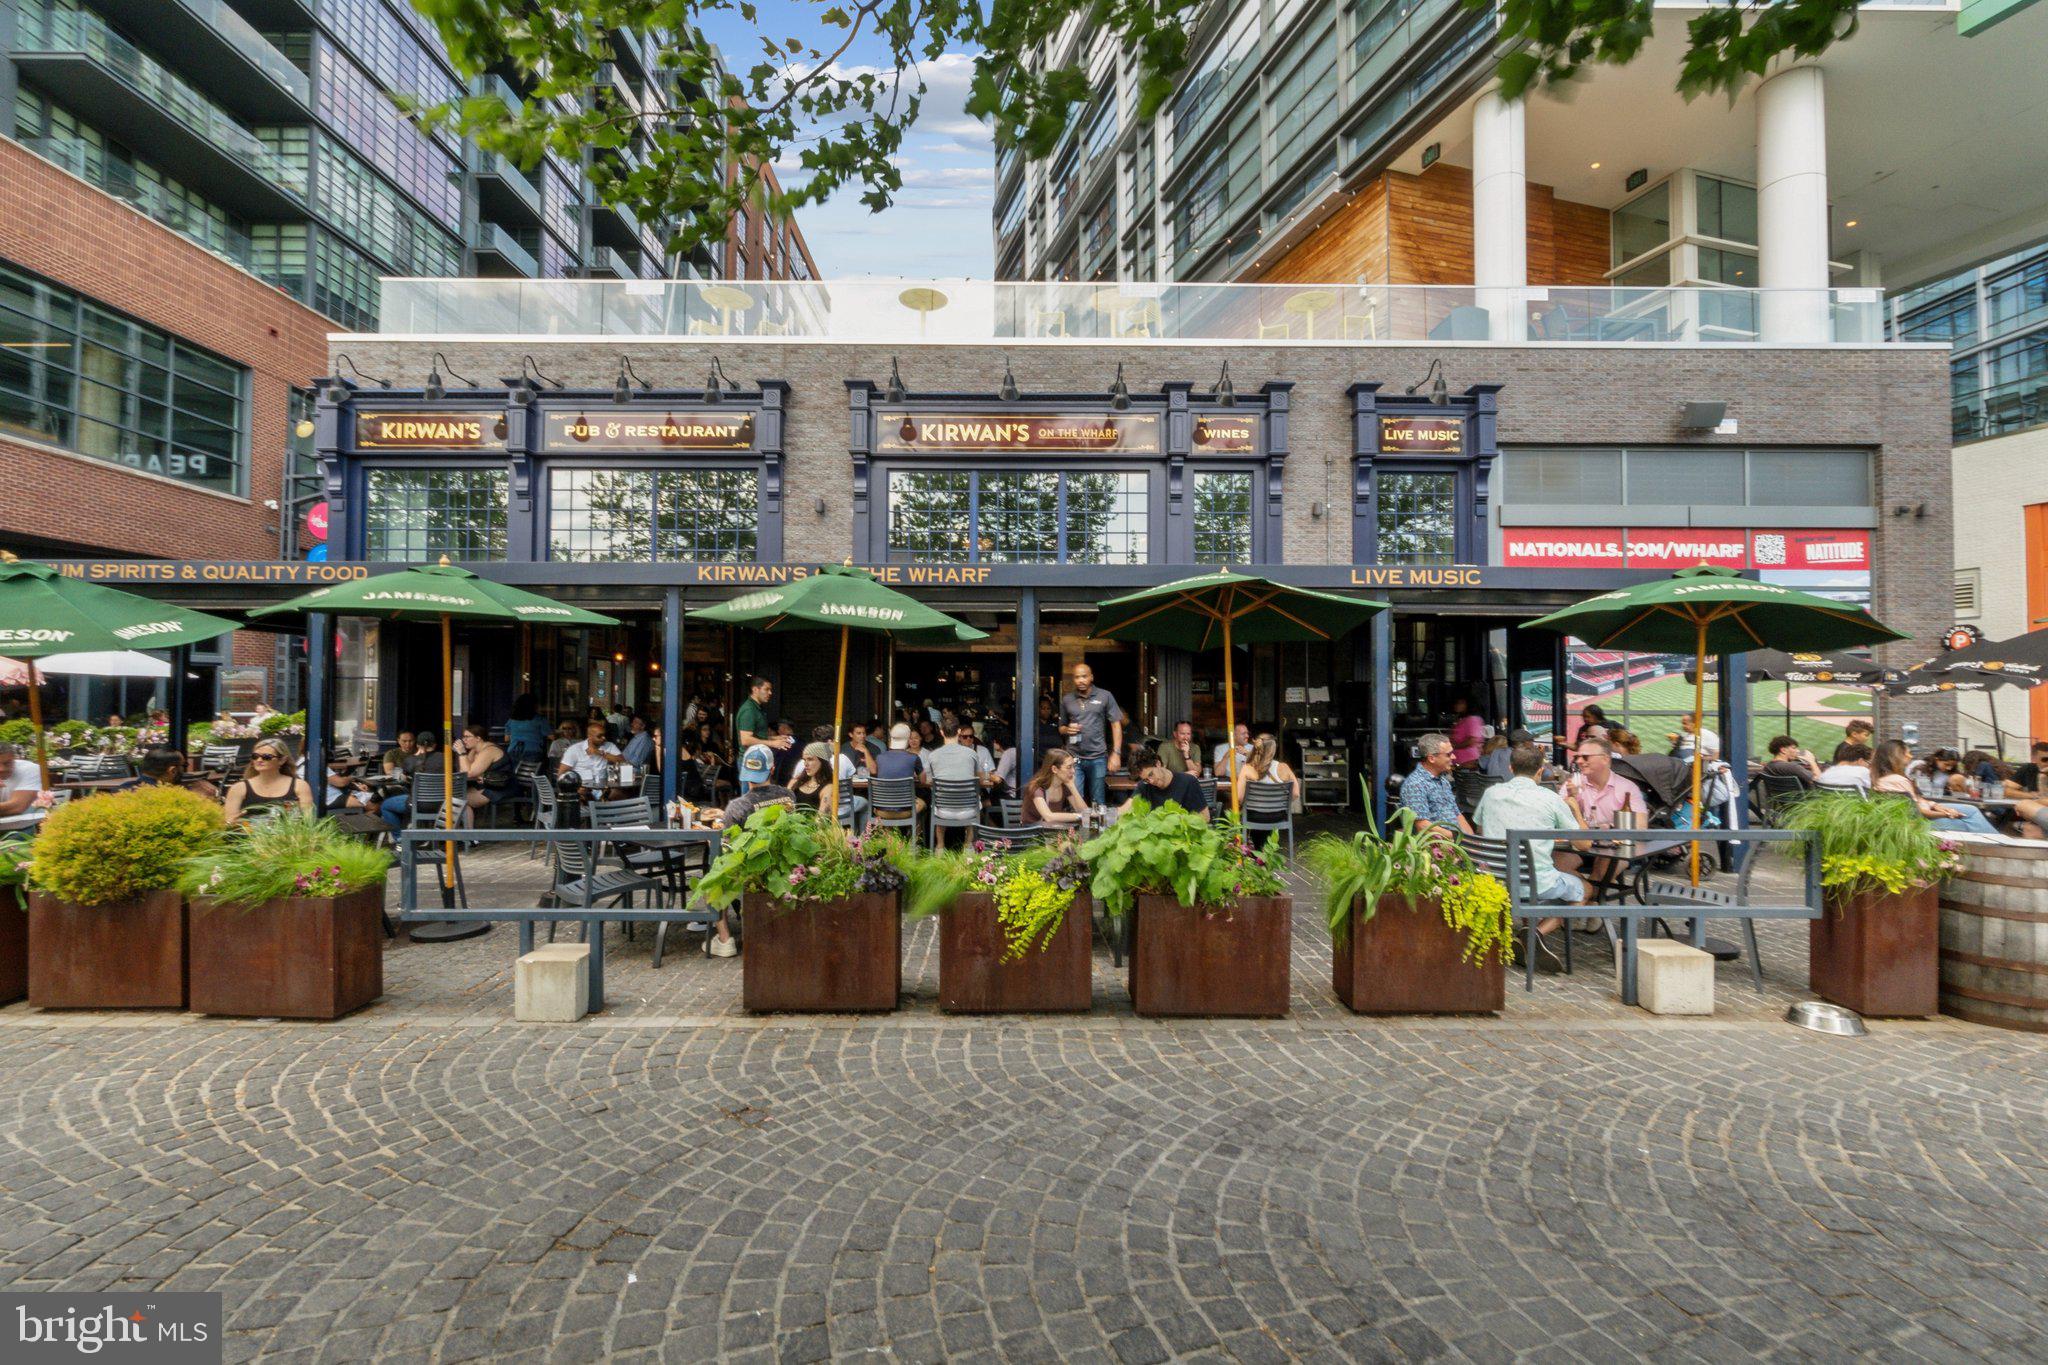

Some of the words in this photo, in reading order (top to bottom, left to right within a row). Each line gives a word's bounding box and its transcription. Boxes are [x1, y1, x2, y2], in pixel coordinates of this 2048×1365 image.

[381, 422, 481, 439] KIRWAN'S
[564, 425, 600, 437] PUB
[605, 422, 621, 439] &
[625, 425, 739, 438] RESTAURANT
[921, 424, 1030, 442] KIRWAN'S
[1038, 428, 1055, 438] ON
[1058, 428, 1078, 438] THE
[1081, 428, 1119, 438] WHARF
[1203, 429, 1250, 439] WINES
[1384, 429, 1414, 441] LIVE
[1417, 430, 1460, 441] MUSIC
[1509, 541, 1744, 559] NATIONALS.COM/WHARF
[1805, 541, 1864, 561] NATITUDE
[90, 564, 175, 579] SPIRITS
[181, 565, 197, 579] &
[202, 565, 300, 580] QUALITY
[306, 565, 368, 580] FOOD
[698, 566, 807, 581] KIRWAN'S
[859, 567, 900, 582] HE
[908, 567, 991, 582] WHARF
[1351, 569, 1403, 584] LIVE
[1409, 569, 1481, 585] MUSIC
[820, 602, 905, 621] JAMESON
[0, 629, 75, 642] ESON
